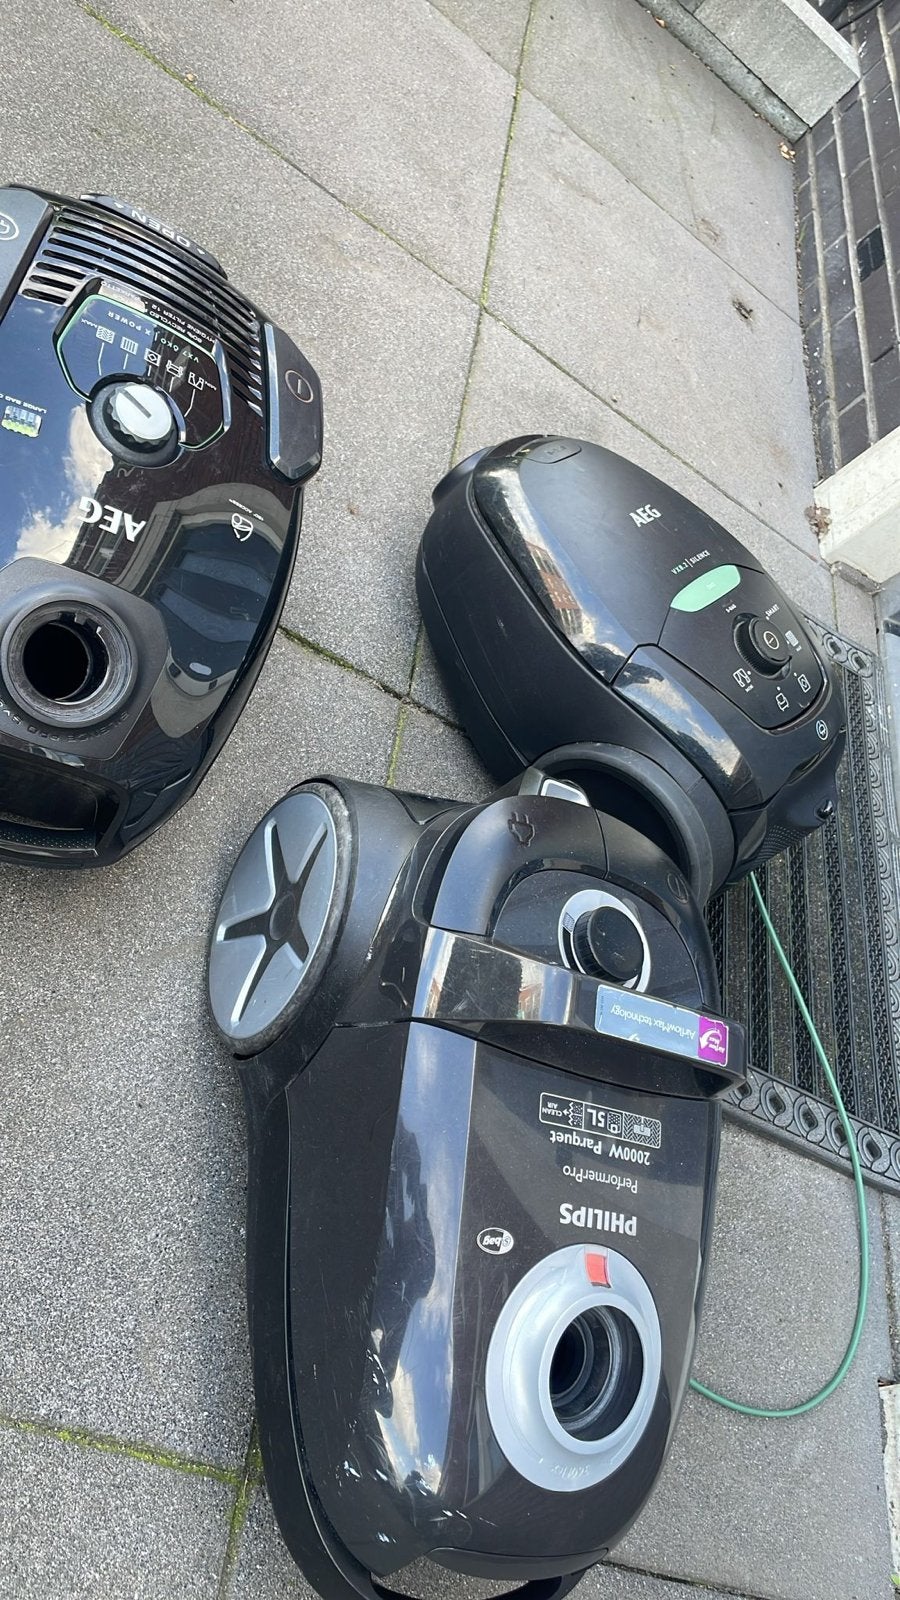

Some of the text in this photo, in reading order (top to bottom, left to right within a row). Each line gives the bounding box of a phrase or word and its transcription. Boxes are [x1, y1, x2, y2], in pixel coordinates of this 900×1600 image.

[131, 209, 191, 248] OPEN
[107, 310, 142, 331] POWER
[149, 311, 186, 333] RECYCLED
[163, 310, 186, 326] FILTER
[76, 496, 147, 543] AEG
[629, 504, 662, 528] AEG
[690, 550, 711, 565] SILENCE
[765, 604, 780, 617] SMART
[611, 1004, 653, 1027] technology
[542, 1107, 562, 1117] CLEAN
[547, 1101, 558, 1109] AIR
[587, 1108, 606, 1128] 5L
[550, 1130, 651, 1166] 2000W Parquet
[563, 1165, 638, 1194] PerformerPro
[559, 1203, 637, 1236] PHILIPS
